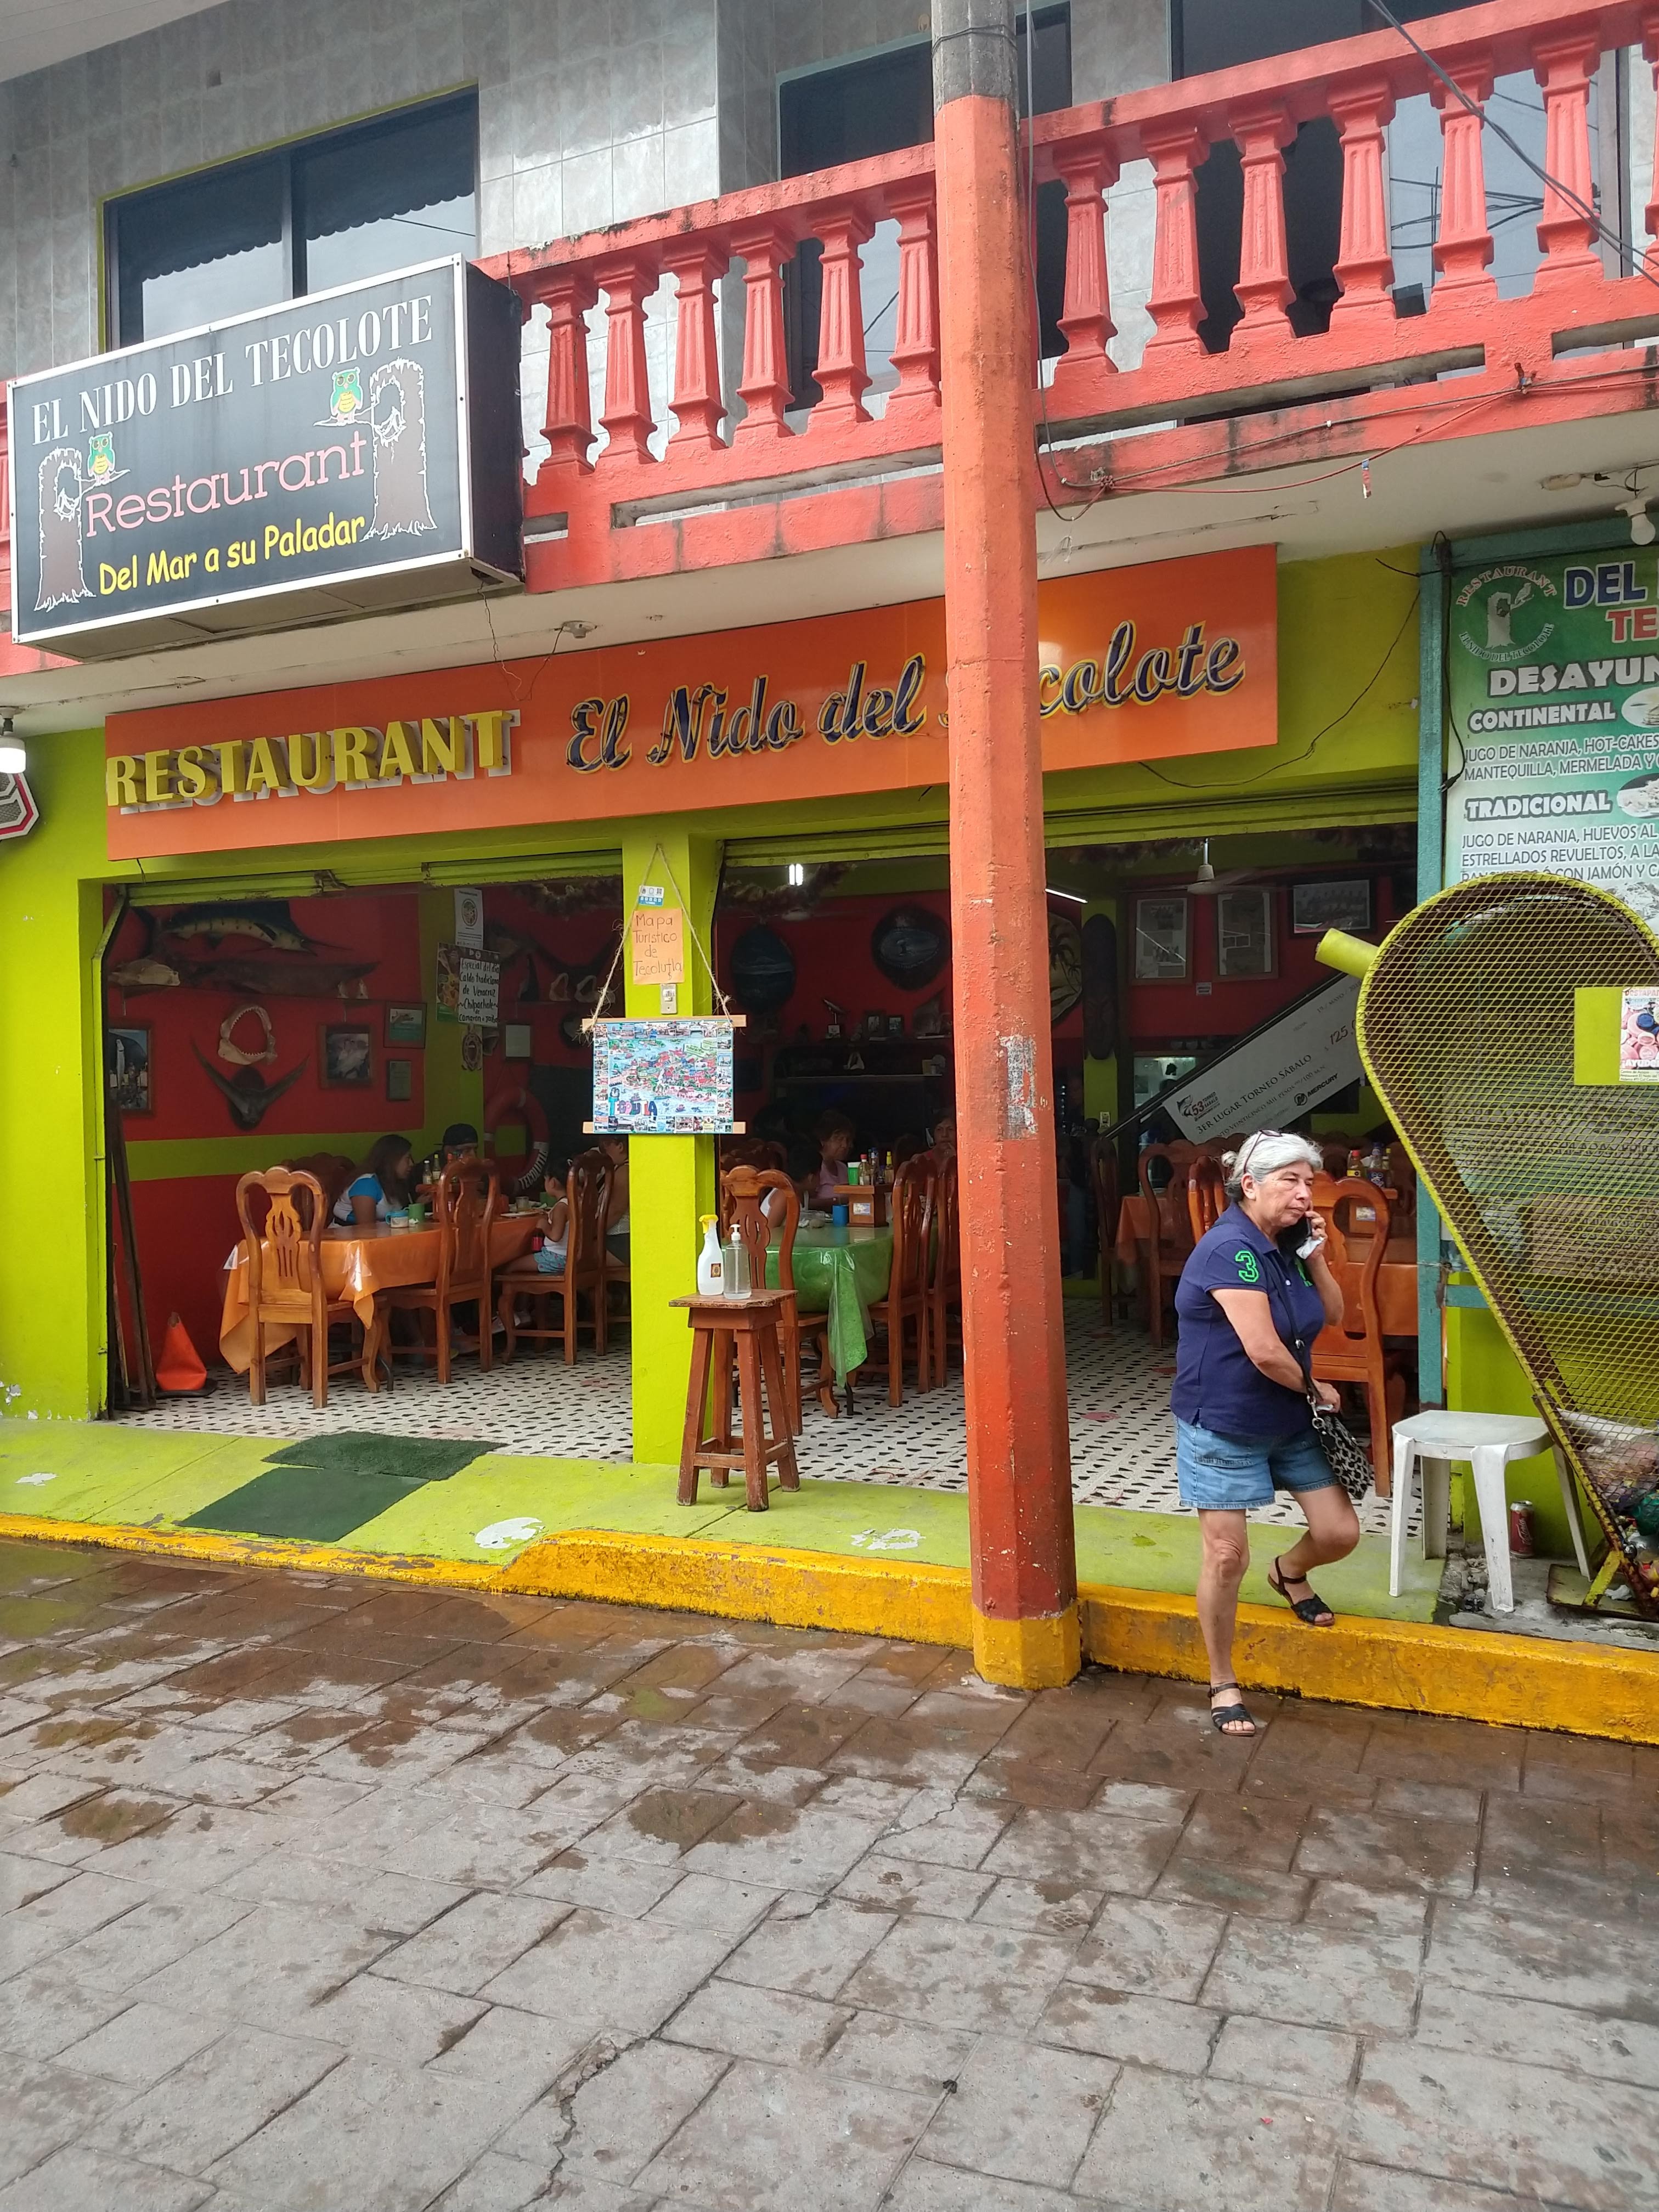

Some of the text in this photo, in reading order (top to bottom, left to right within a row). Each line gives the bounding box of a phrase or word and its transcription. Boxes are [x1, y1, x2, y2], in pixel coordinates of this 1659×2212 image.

[32, 295, 433, 445] EL NIDO DEL TECOLOTE
[86, 430, 368, 538] Restaurant
[99, 511, 366, 596] Del Mar a su Paladar
[1456, 566, 1558, 607] RESTAURANT
[1563, 560, 1648, 610] DEL
[566, 619, 1245, 774] El Nido del colote
[1469, 701, 1617, 733] CONTINENTAL
[1499, 746, 1515, 759] DE
[1519, 740, 1581, 758] NARANJA,
[1585, 734, 1659, 753] HOT-CAKES
[107, 709, 519, 813] RESTAURANT
[1465, 754, 1654, 781] MANTEQUILLA, MERMELADA Y
[1465, 791, 1613, 821] TRADICIONAL
[1463, 825, 1657, 849] JUGO DE NARANJA, HUEVOS AL
[1462, 850, 1547, 866] ESTRELLADOS
[1550, 846, 1627, 862] REVUELTOS,
[1630, 845, 1640, 859] A
[1587, 862, 1633, 881] JAMÓN
[1636, 865, 1645, 877] Y
[636, 913, 673, 929] Mapa
[461, 958, 482, 970] Especial
[645, 944, 658, 958] de
[460, 972, 475, 983] Caldo
[634, 957, 682, 977] Tecolutla
[462, 984, 495, 997] de Veracruz
[1213, 1102, 1243, 1123] LUGAR
[1240, 1076, 1278, 1104] TORNEO
[1278, 1054, 1311, 1079] SÁBALO
[1307, 1073, 1338, 1097] MERCURY
[1192, 1101, 1205, 1116] 53
[1235, 1250, 1260, 1283] 3
